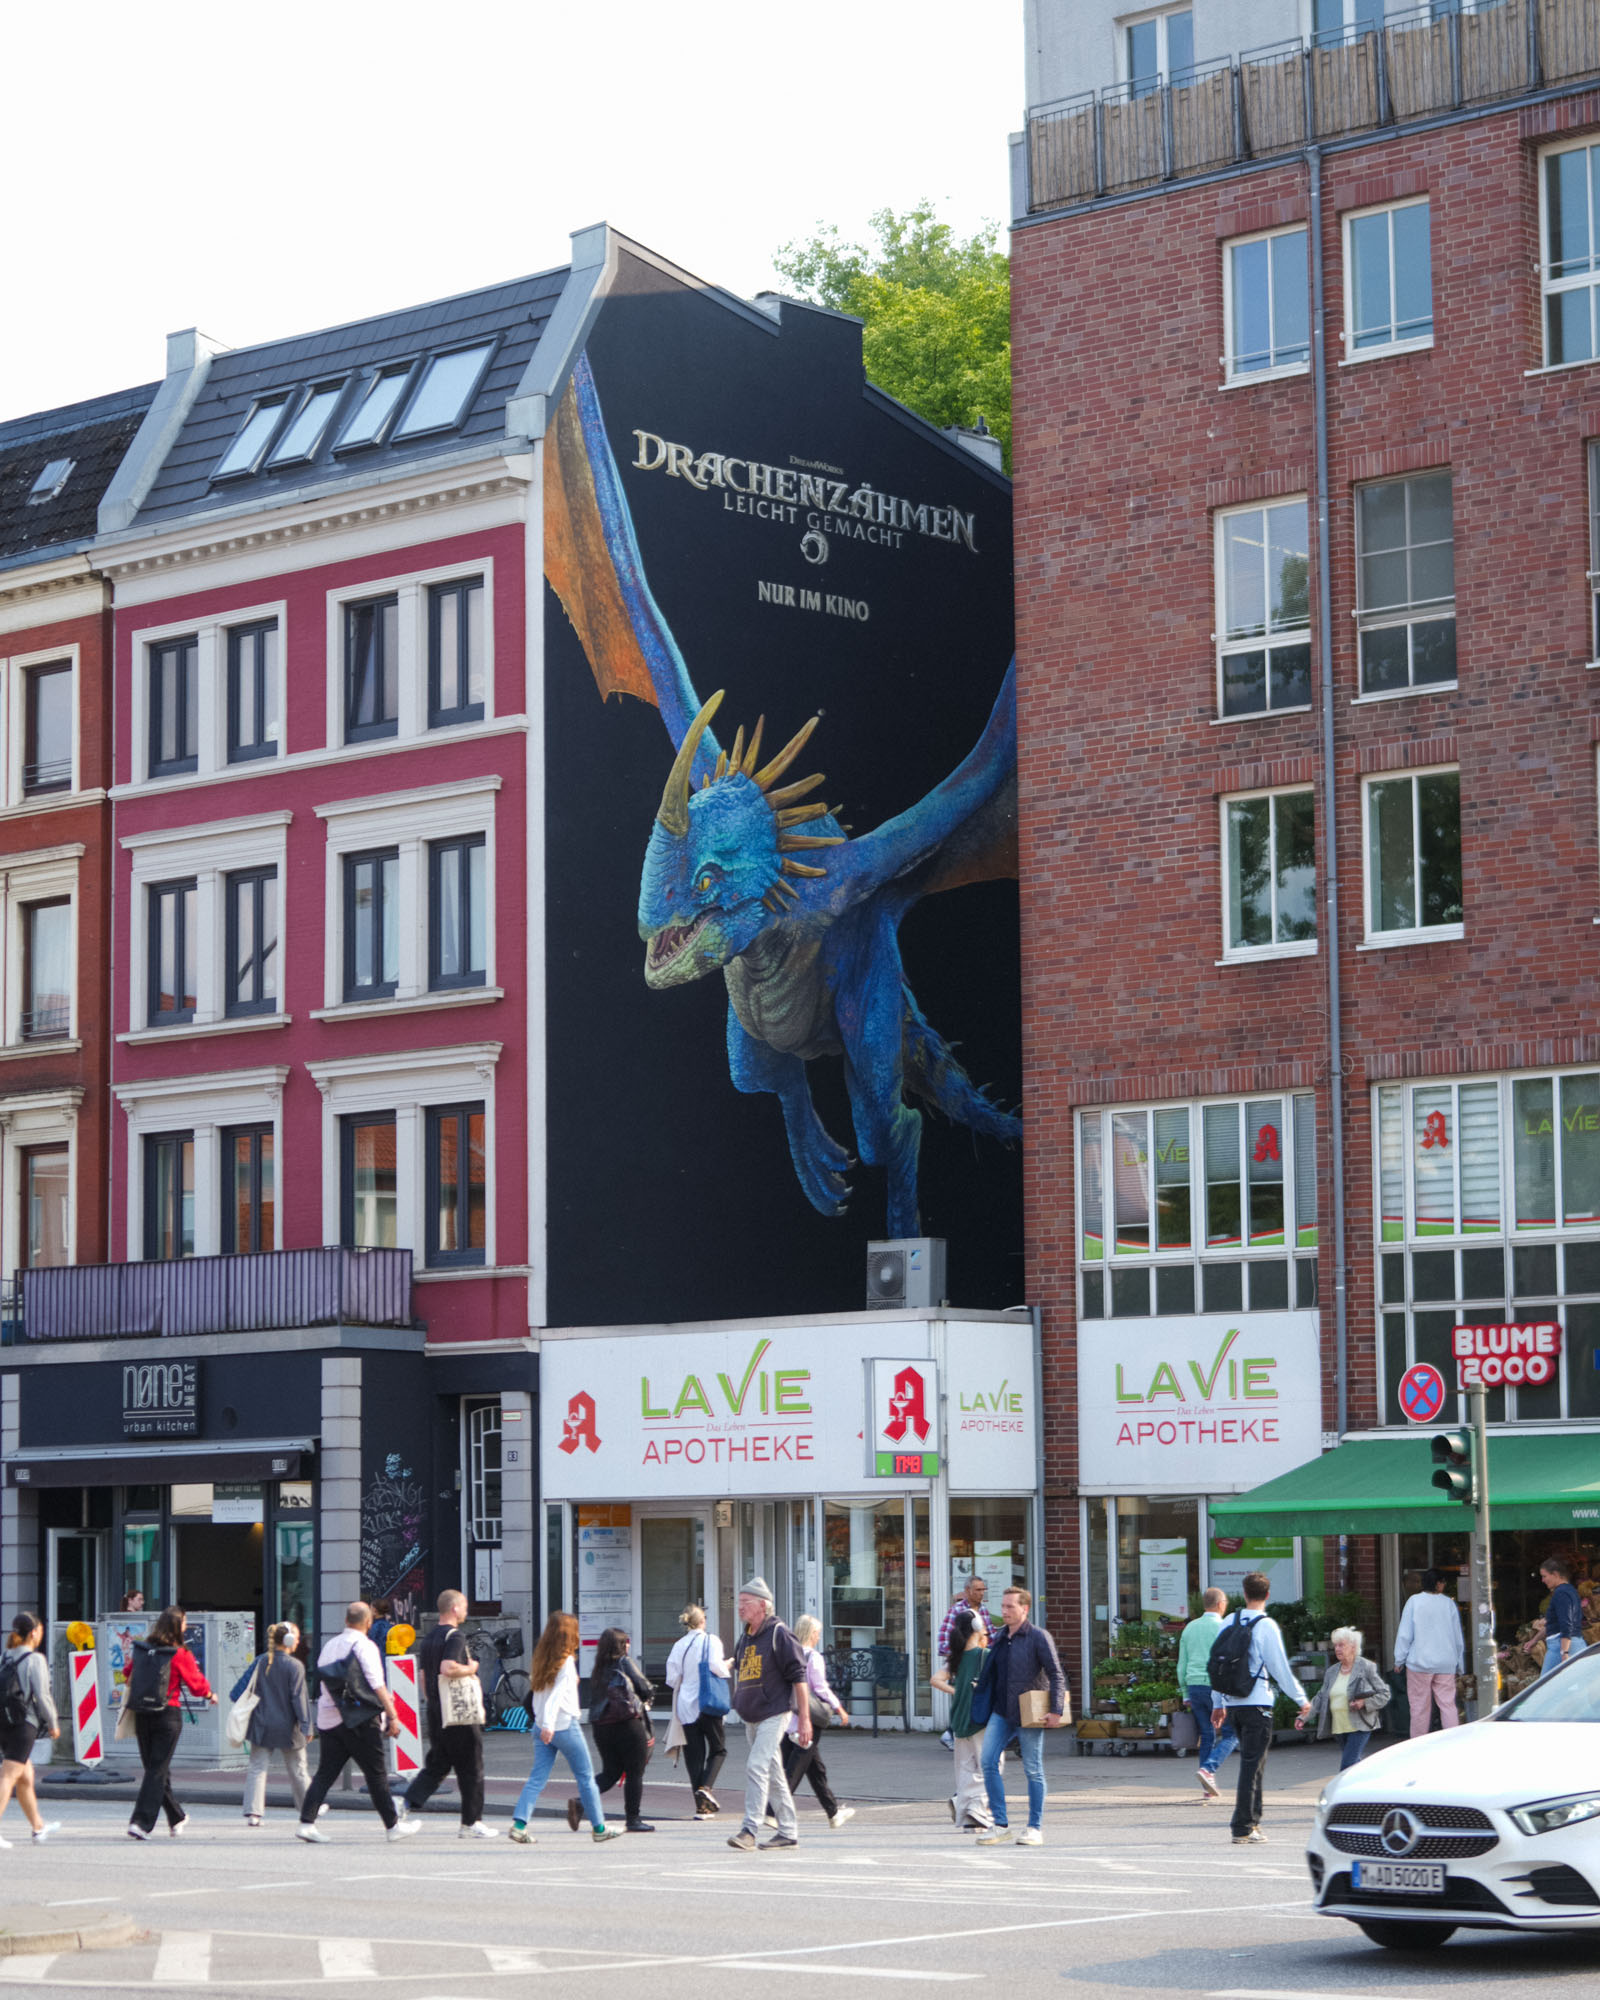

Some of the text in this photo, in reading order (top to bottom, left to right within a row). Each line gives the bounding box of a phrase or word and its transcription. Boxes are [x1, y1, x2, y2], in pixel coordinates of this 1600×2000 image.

[632, 429, 978, 552] DRACHENZÄHMEN
[724, 492, 903, 549] LEICHT GEMACHT
[758, 580, 869, 621] NUR IM KINO
[1455, 1325, 1554, 1355] BLUME
[1463, 1355, 1548, 1383] 2000
[184, 1364, 195, 1406] MEAT
[1177, 1406, 1215, 1416] Das Leben
[123, 1420, 195, 1432] urban kitchen
[706, 1421, 746, 1432] Das Leben
[960, 1420, 1024, 1432] APOTHEKE
[1116, 1419, 1279, 1446] APOTHEKE
[642, 1435, 814, 1465] APOTHEKE
